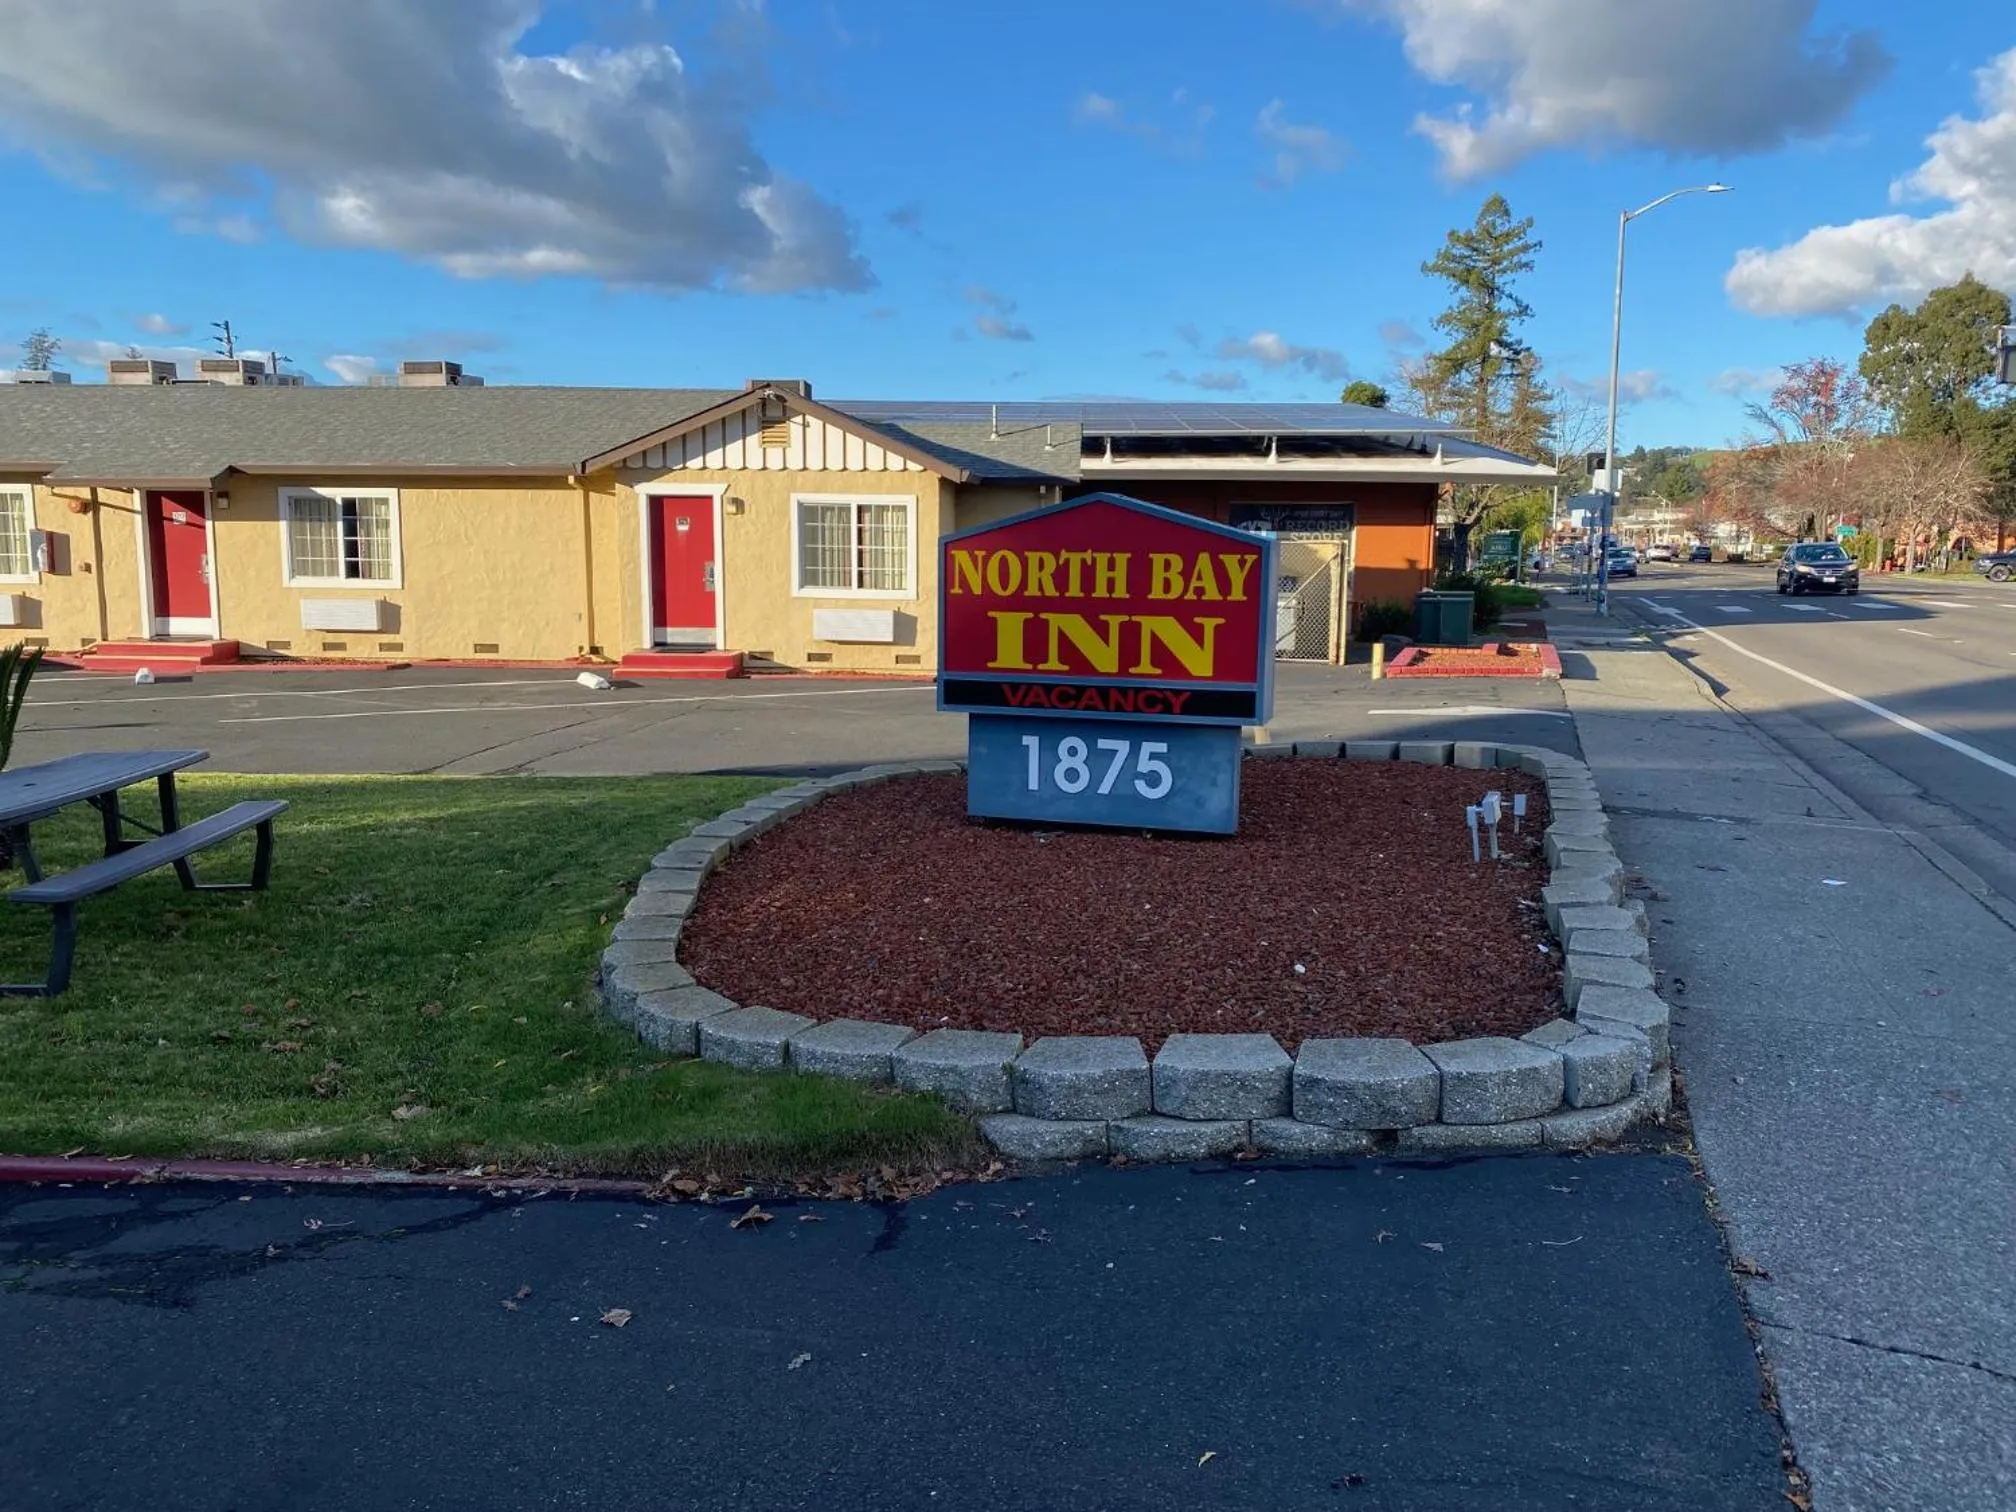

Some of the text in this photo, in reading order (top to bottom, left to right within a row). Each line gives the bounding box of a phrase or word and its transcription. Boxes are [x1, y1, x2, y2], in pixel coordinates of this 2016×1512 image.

[1286, 520, 1350, 532] RECORD
[950, 549, 1258, 601] NORTH BAY
[988, 611, 1226, 677] INN
[1002, 685, 1191, 714] VACANCY
[1022, 736, 1173, 799] 1875
